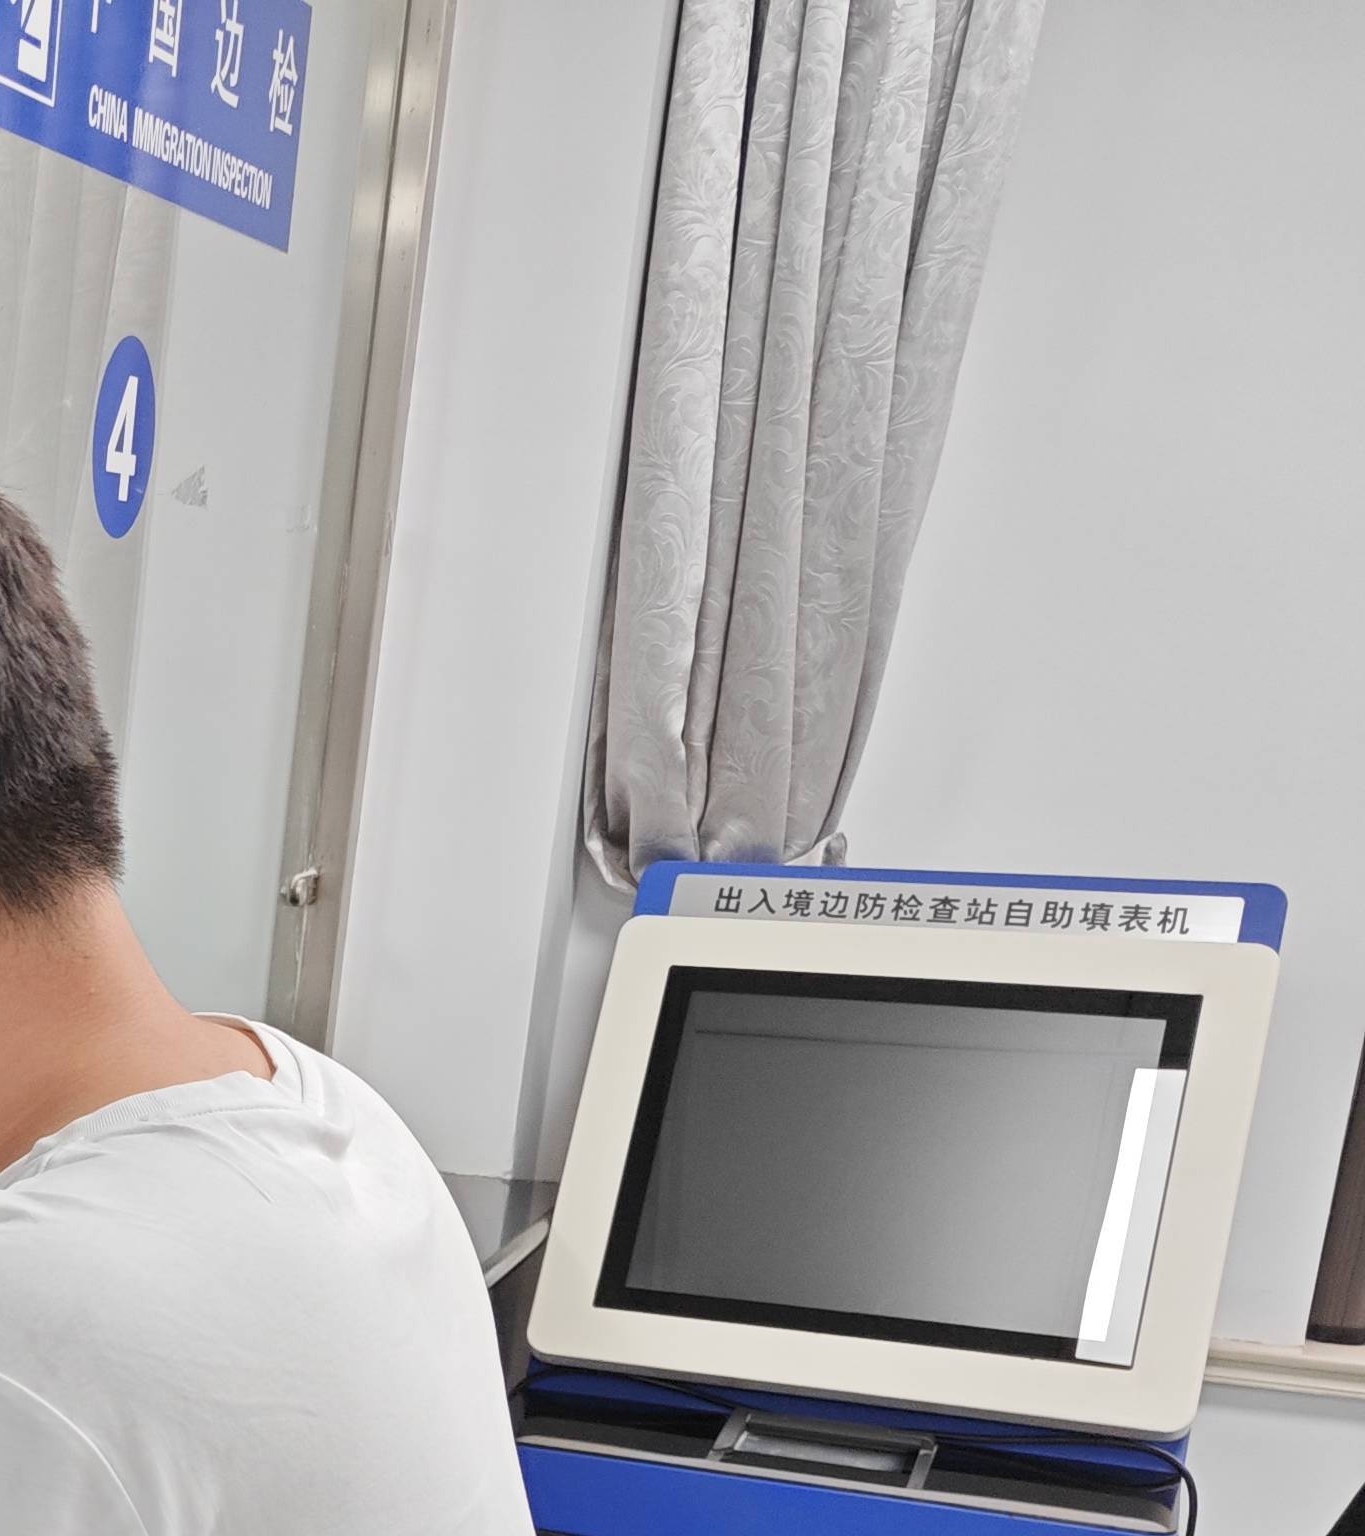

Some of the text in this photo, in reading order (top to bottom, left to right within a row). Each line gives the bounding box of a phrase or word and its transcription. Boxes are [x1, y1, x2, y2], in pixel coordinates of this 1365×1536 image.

[88, 84, 273, 210] CHINA IMMIGRATION INSPECTION
[105, 376, 139, 502] 4
[714, 886, 1190, 935] 出入境边防检查站自助填表机
